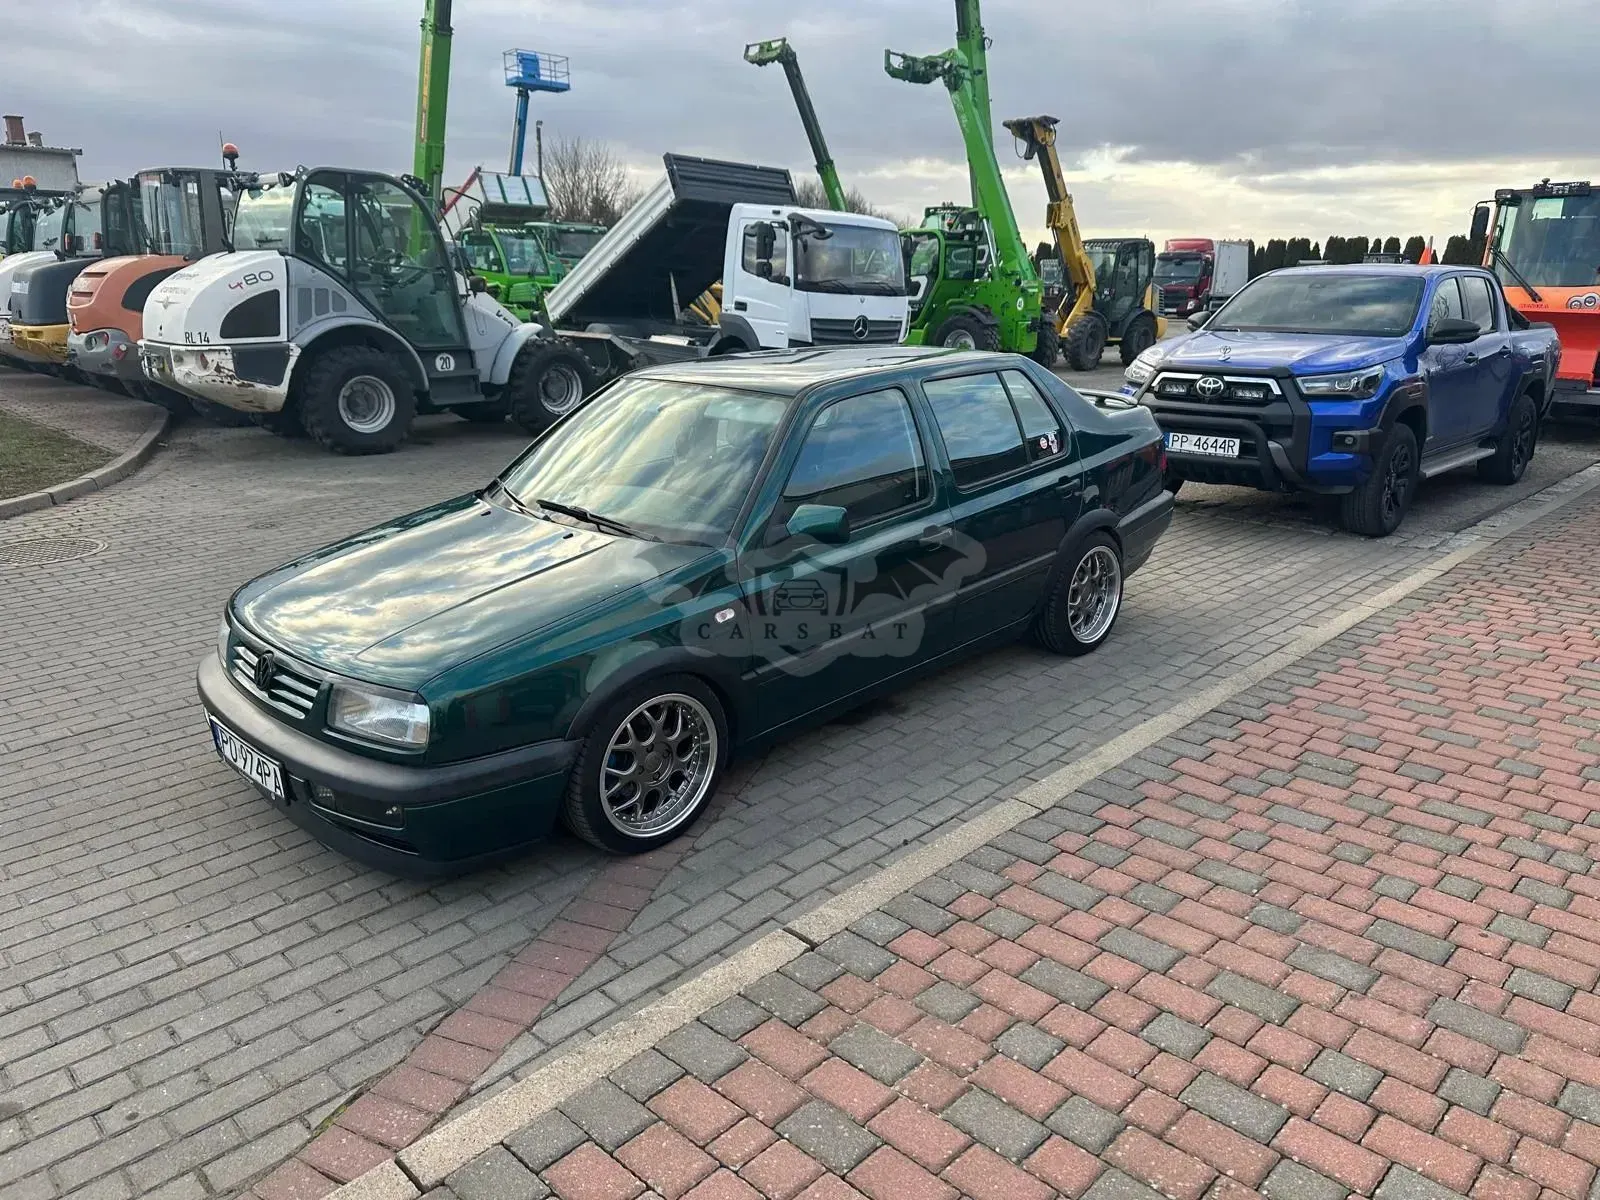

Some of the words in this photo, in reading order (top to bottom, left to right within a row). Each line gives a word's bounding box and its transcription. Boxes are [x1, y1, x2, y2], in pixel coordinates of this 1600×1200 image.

[228, 270, 274, 290] 480
[184, 331, 196, 343] RL
[198, 331, 210, 343] 14
[439, 356, 451, 369] 20
[1171, 434, 1189, 448] PP
[1193, 437, 1236, 453] 4644R
[219, 730, 238, 763] PO
[240, 744, 284, 797] 974PA
